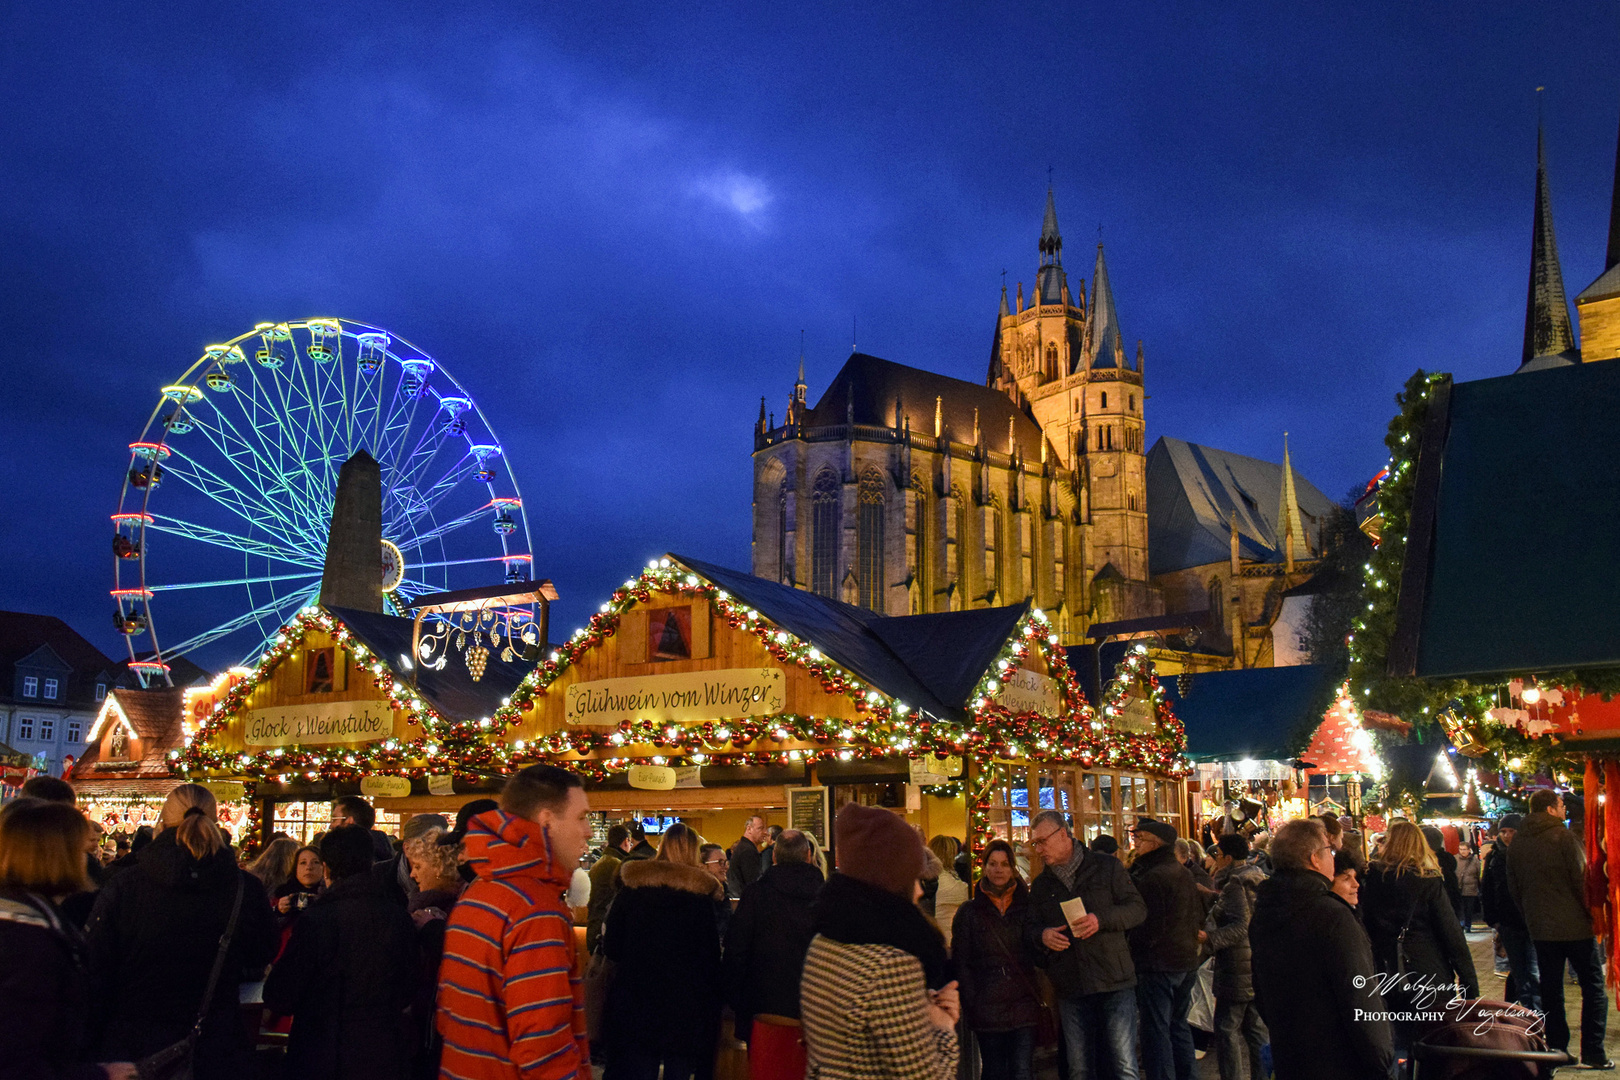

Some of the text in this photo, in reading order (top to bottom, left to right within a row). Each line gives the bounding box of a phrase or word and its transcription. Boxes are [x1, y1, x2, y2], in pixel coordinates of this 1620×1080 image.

[575, 682, 772, 718] Glühwein vom Winzer
[998, 693, 1056, 716] Weinstube
[306, 710, 384, 736] Weinstube
